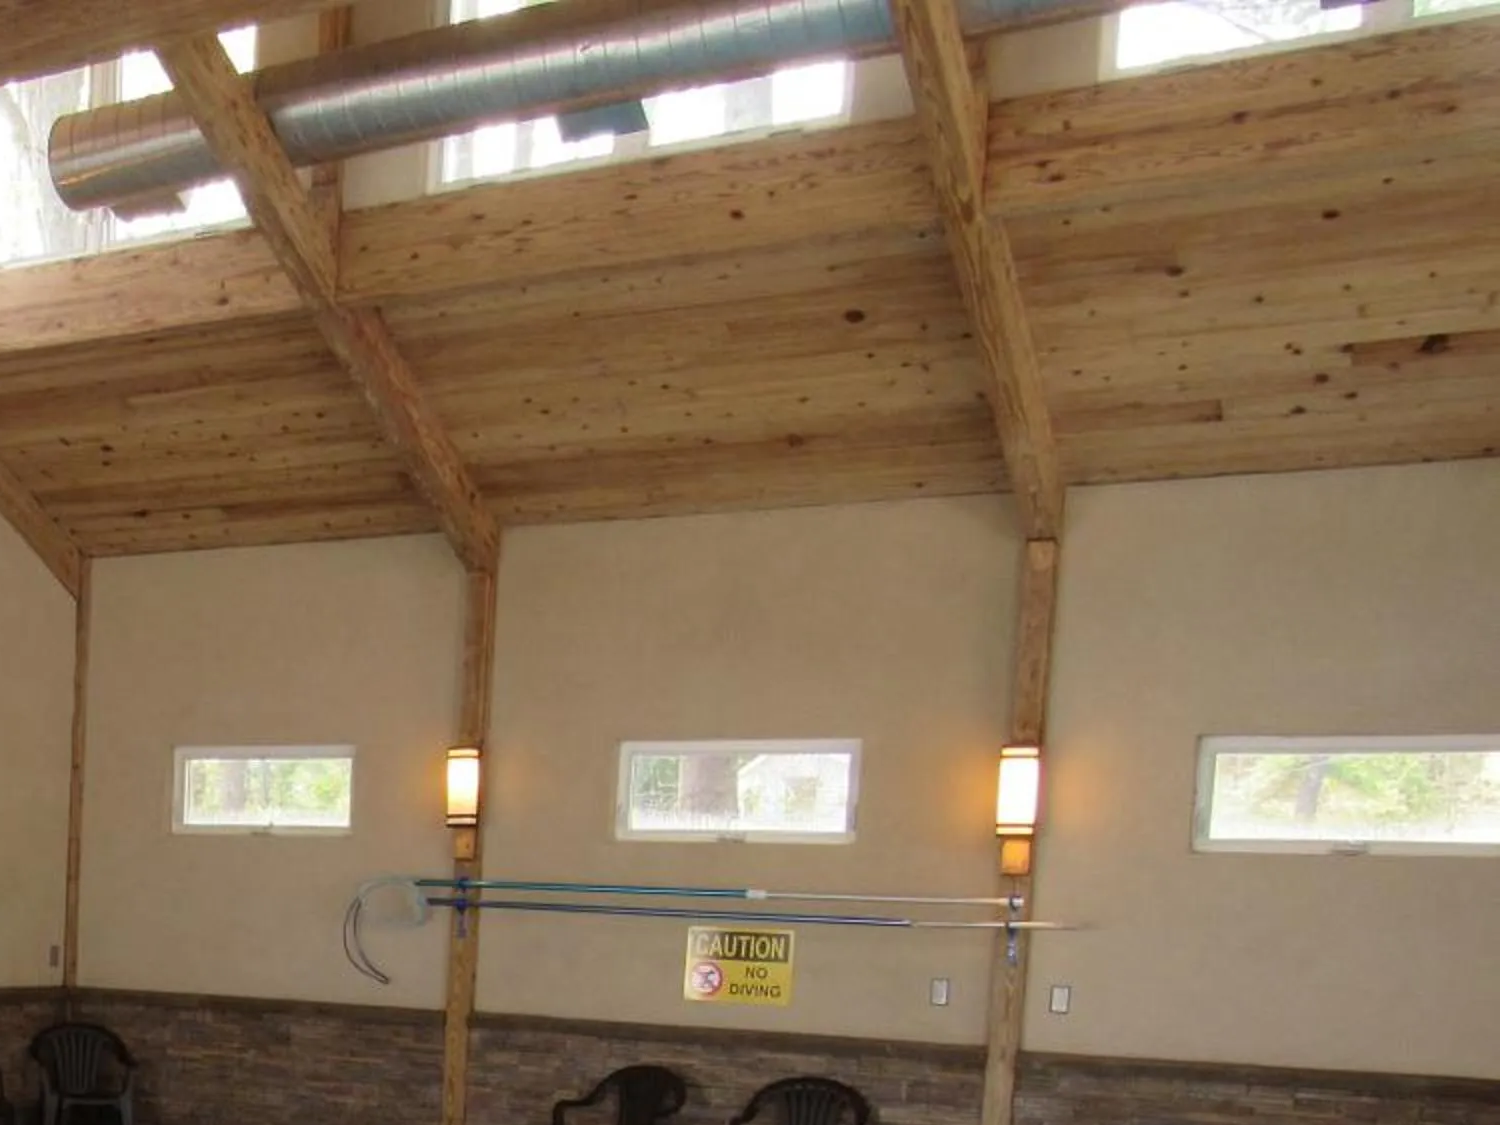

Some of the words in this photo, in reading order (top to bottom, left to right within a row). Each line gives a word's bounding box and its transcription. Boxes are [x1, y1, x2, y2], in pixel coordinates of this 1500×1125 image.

[696, 933, 785, 959] CAUTION
[745, 967, 768, 979] NO
[728, 983, 781, 998] DIVING
